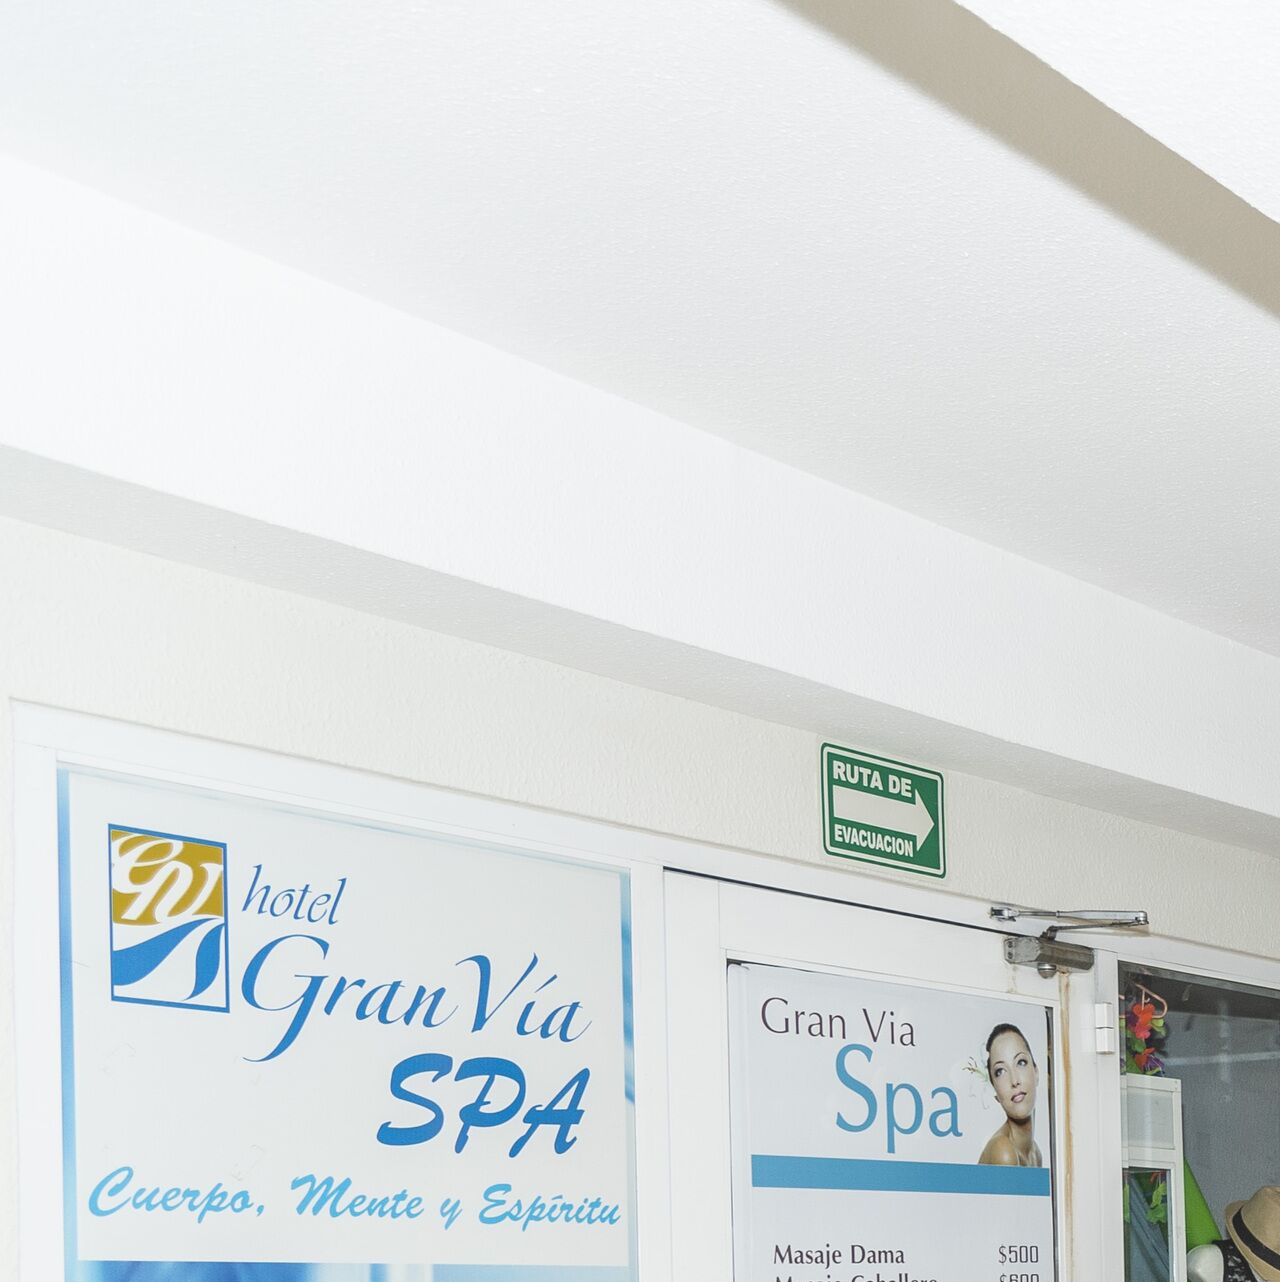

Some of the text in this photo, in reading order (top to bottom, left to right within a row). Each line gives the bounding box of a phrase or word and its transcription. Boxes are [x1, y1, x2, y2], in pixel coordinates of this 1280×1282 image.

[832, 760, 912, 798] RUTA DE
[833, 823, 914, 858] EVACUACION
[241, 865, 347, 926] hotel
[760, 997, 916, 1047] Gran Via
[376, 1053, 592, 1158] SPA
[834, 1043, 963, 1154] Spa
[87, 1166, 622, 1230] Cuerpo, Mente y Espíritu
[773, 1243, 1040, 1270] Masaje Dama $500
